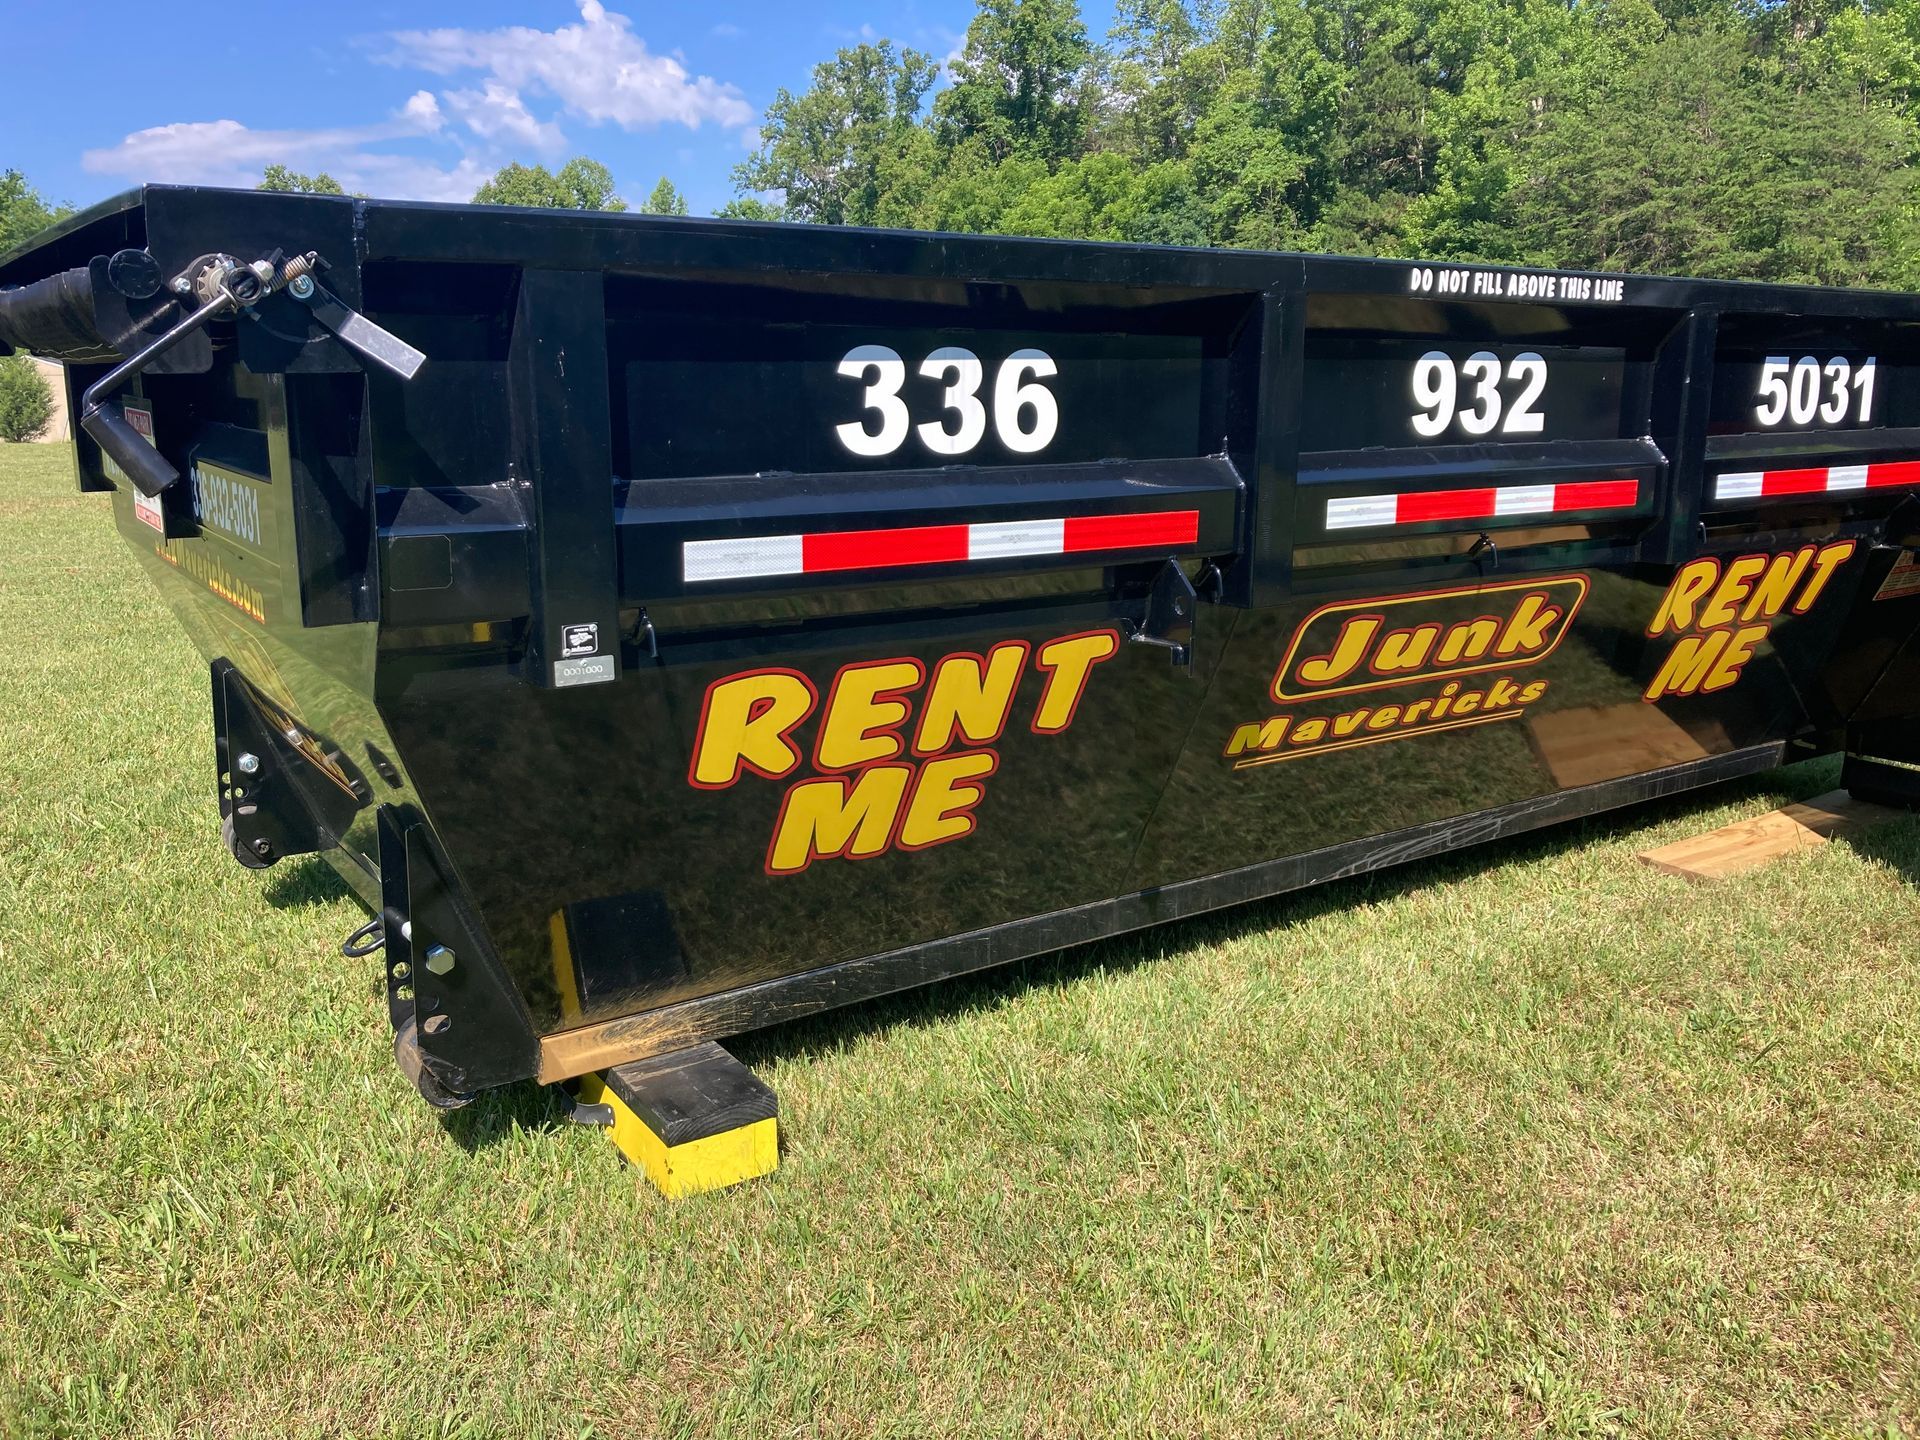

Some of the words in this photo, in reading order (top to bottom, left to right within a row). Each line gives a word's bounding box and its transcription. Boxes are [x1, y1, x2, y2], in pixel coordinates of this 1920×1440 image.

[1411, 268, 1433, 291] DO
[1438, 269, 1470, 293] NOT
[1473, 271, 1503, 295] FILL
[1507, 273, 1556, 298] ABOVE
[1560, 276, 1590, 300] THIS
[1594, 279, 1624, 301] LINE
[836, 344, 1058, 456] 336
[1411, 350, 1548, 436] 932
[1755, 355, 1876, 426] 5031
[190, 466, 261, 545] 336-932-5031
[1644, 540, 1857, 638] RENT
[1295, 591, 1563, 686] Junk
[1641, 621, 1772, 704] ME
[688, 628, 1119, 789] RENT
[1223, 677, 1549, 757] Mavericks
[764, 749, 999, 876] ME
